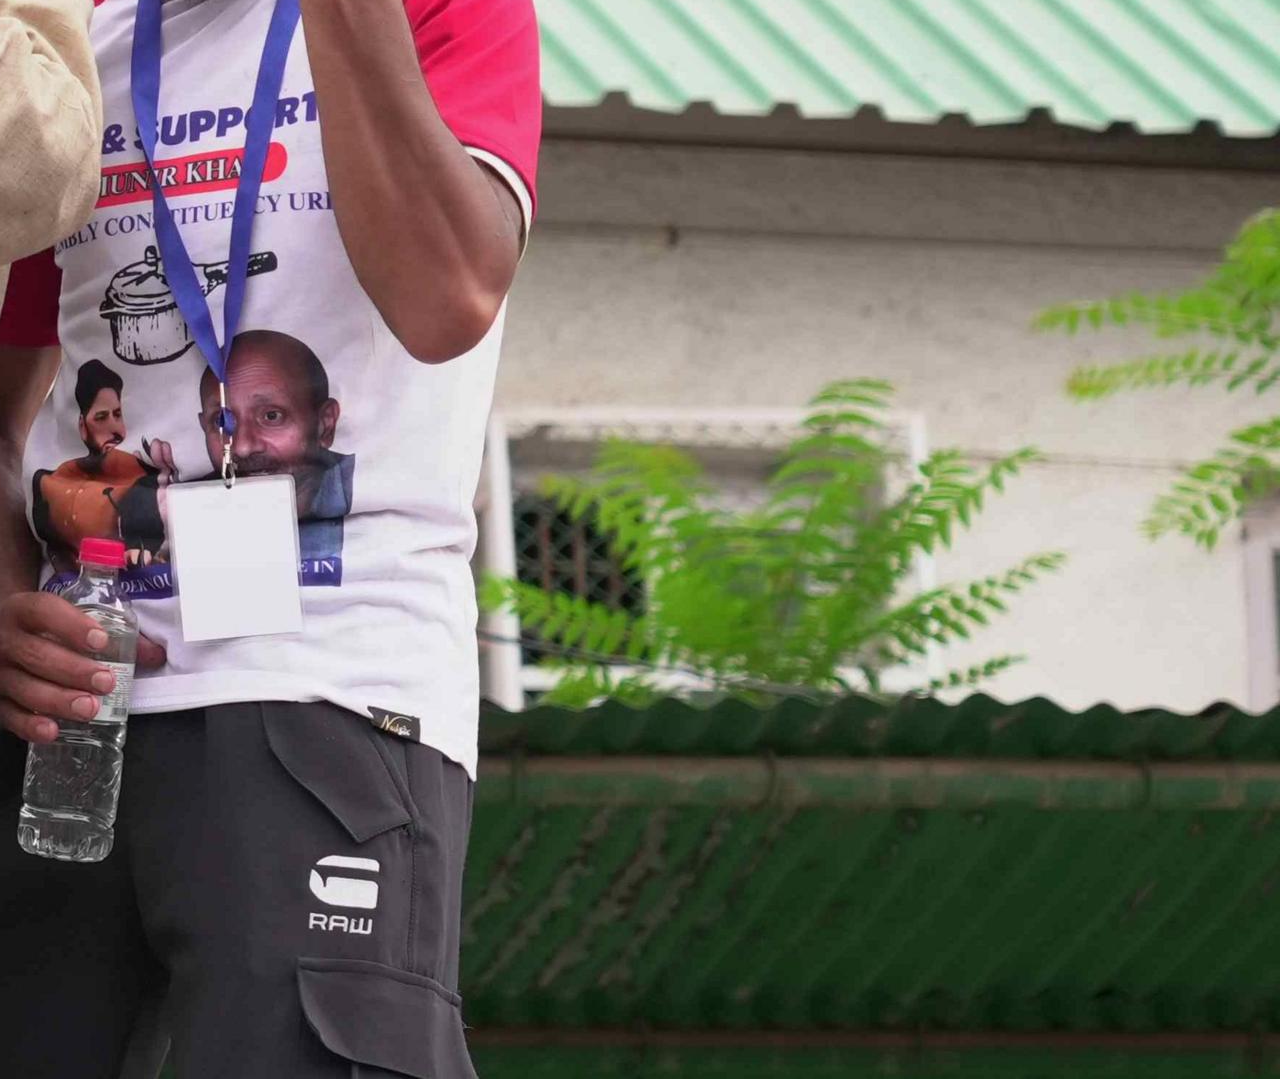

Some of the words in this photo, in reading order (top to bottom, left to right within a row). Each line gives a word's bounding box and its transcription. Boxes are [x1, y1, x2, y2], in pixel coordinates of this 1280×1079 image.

[101, 123, 127, 155] &
[133, 90, 319, 151] UPPRT
[103, 193, 282, 238] CONTITUECY
[308, 912, 373, 935] RAW
